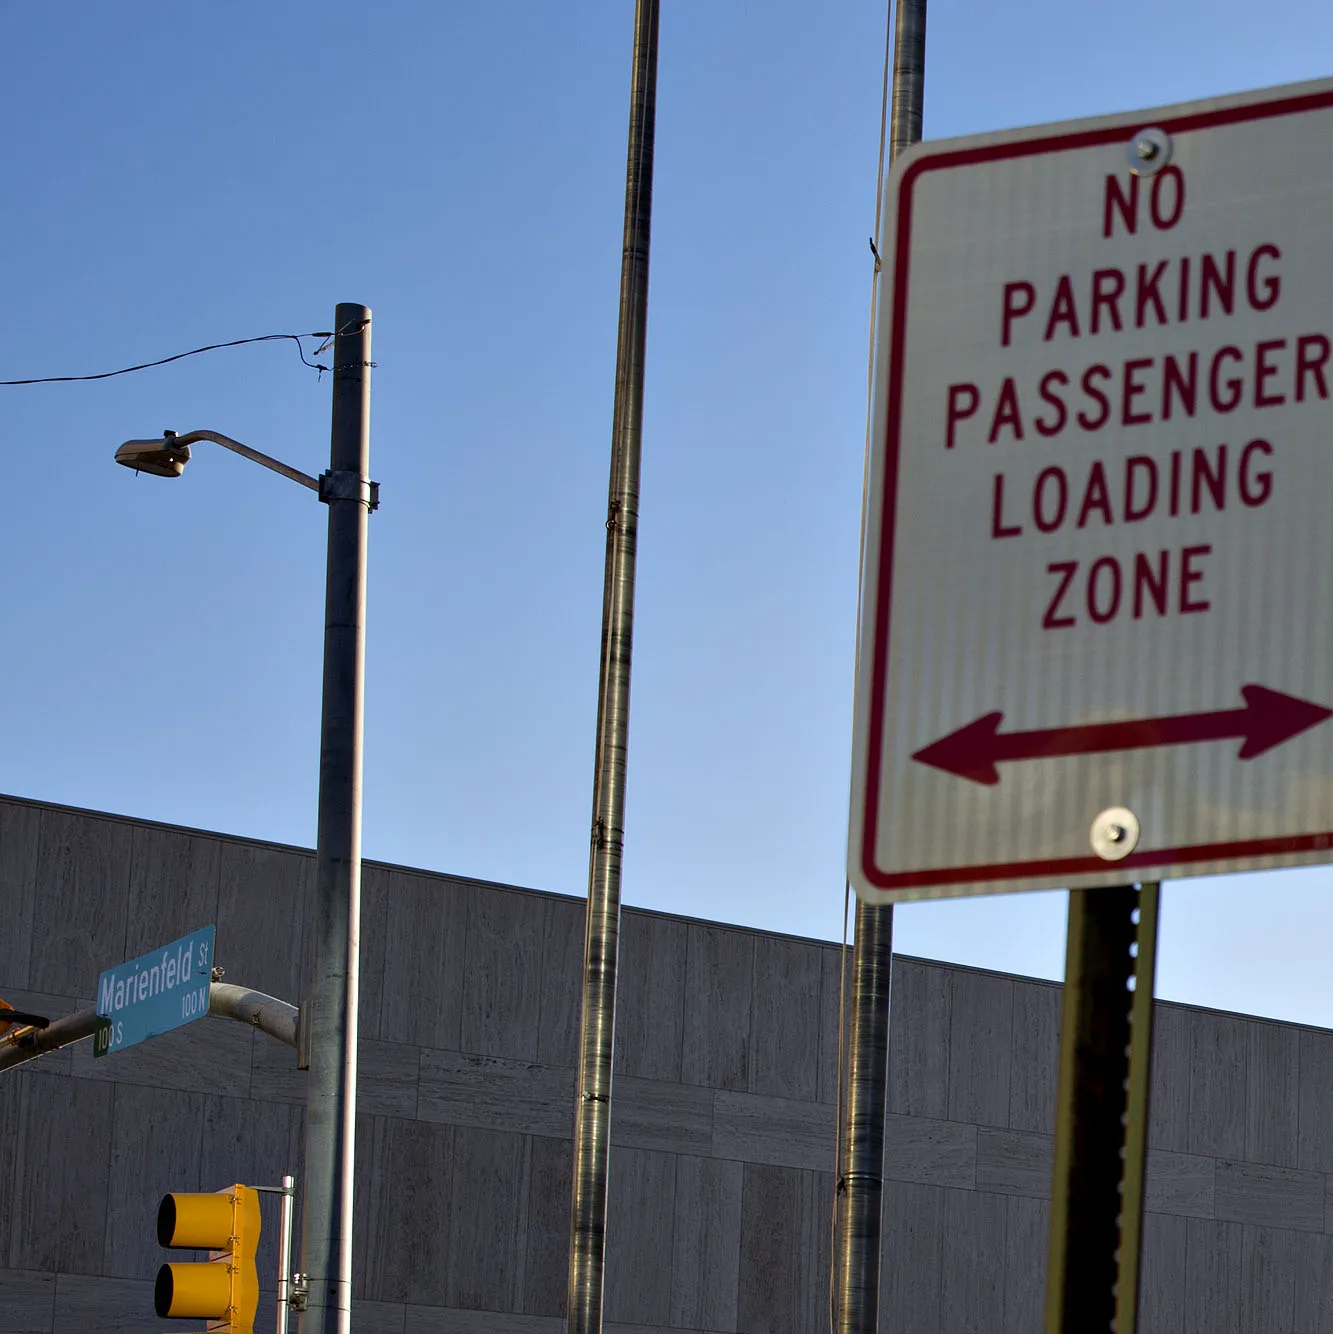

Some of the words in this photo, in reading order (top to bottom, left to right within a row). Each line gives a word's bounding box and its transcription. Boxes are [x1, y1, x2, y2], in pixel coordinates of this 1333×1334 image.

[1101, 164, 1187, 238] NO
[999, 243, 1283, 348] PARKING
[944, 333, 1332, 450] PASSENGER
[991, 437, 1274, 540] LOADING
[1041, 545, 1213, 629] ZONE
[100, 940, 194, 1014] Marienfeld
[198, 941, 209, 967] St
[181, 991, 197, 1018] 100
[198, 986, 206, 1012] N
[98, 1024, 114, 1051] 100
[116, 1021, 123, 1044] S
